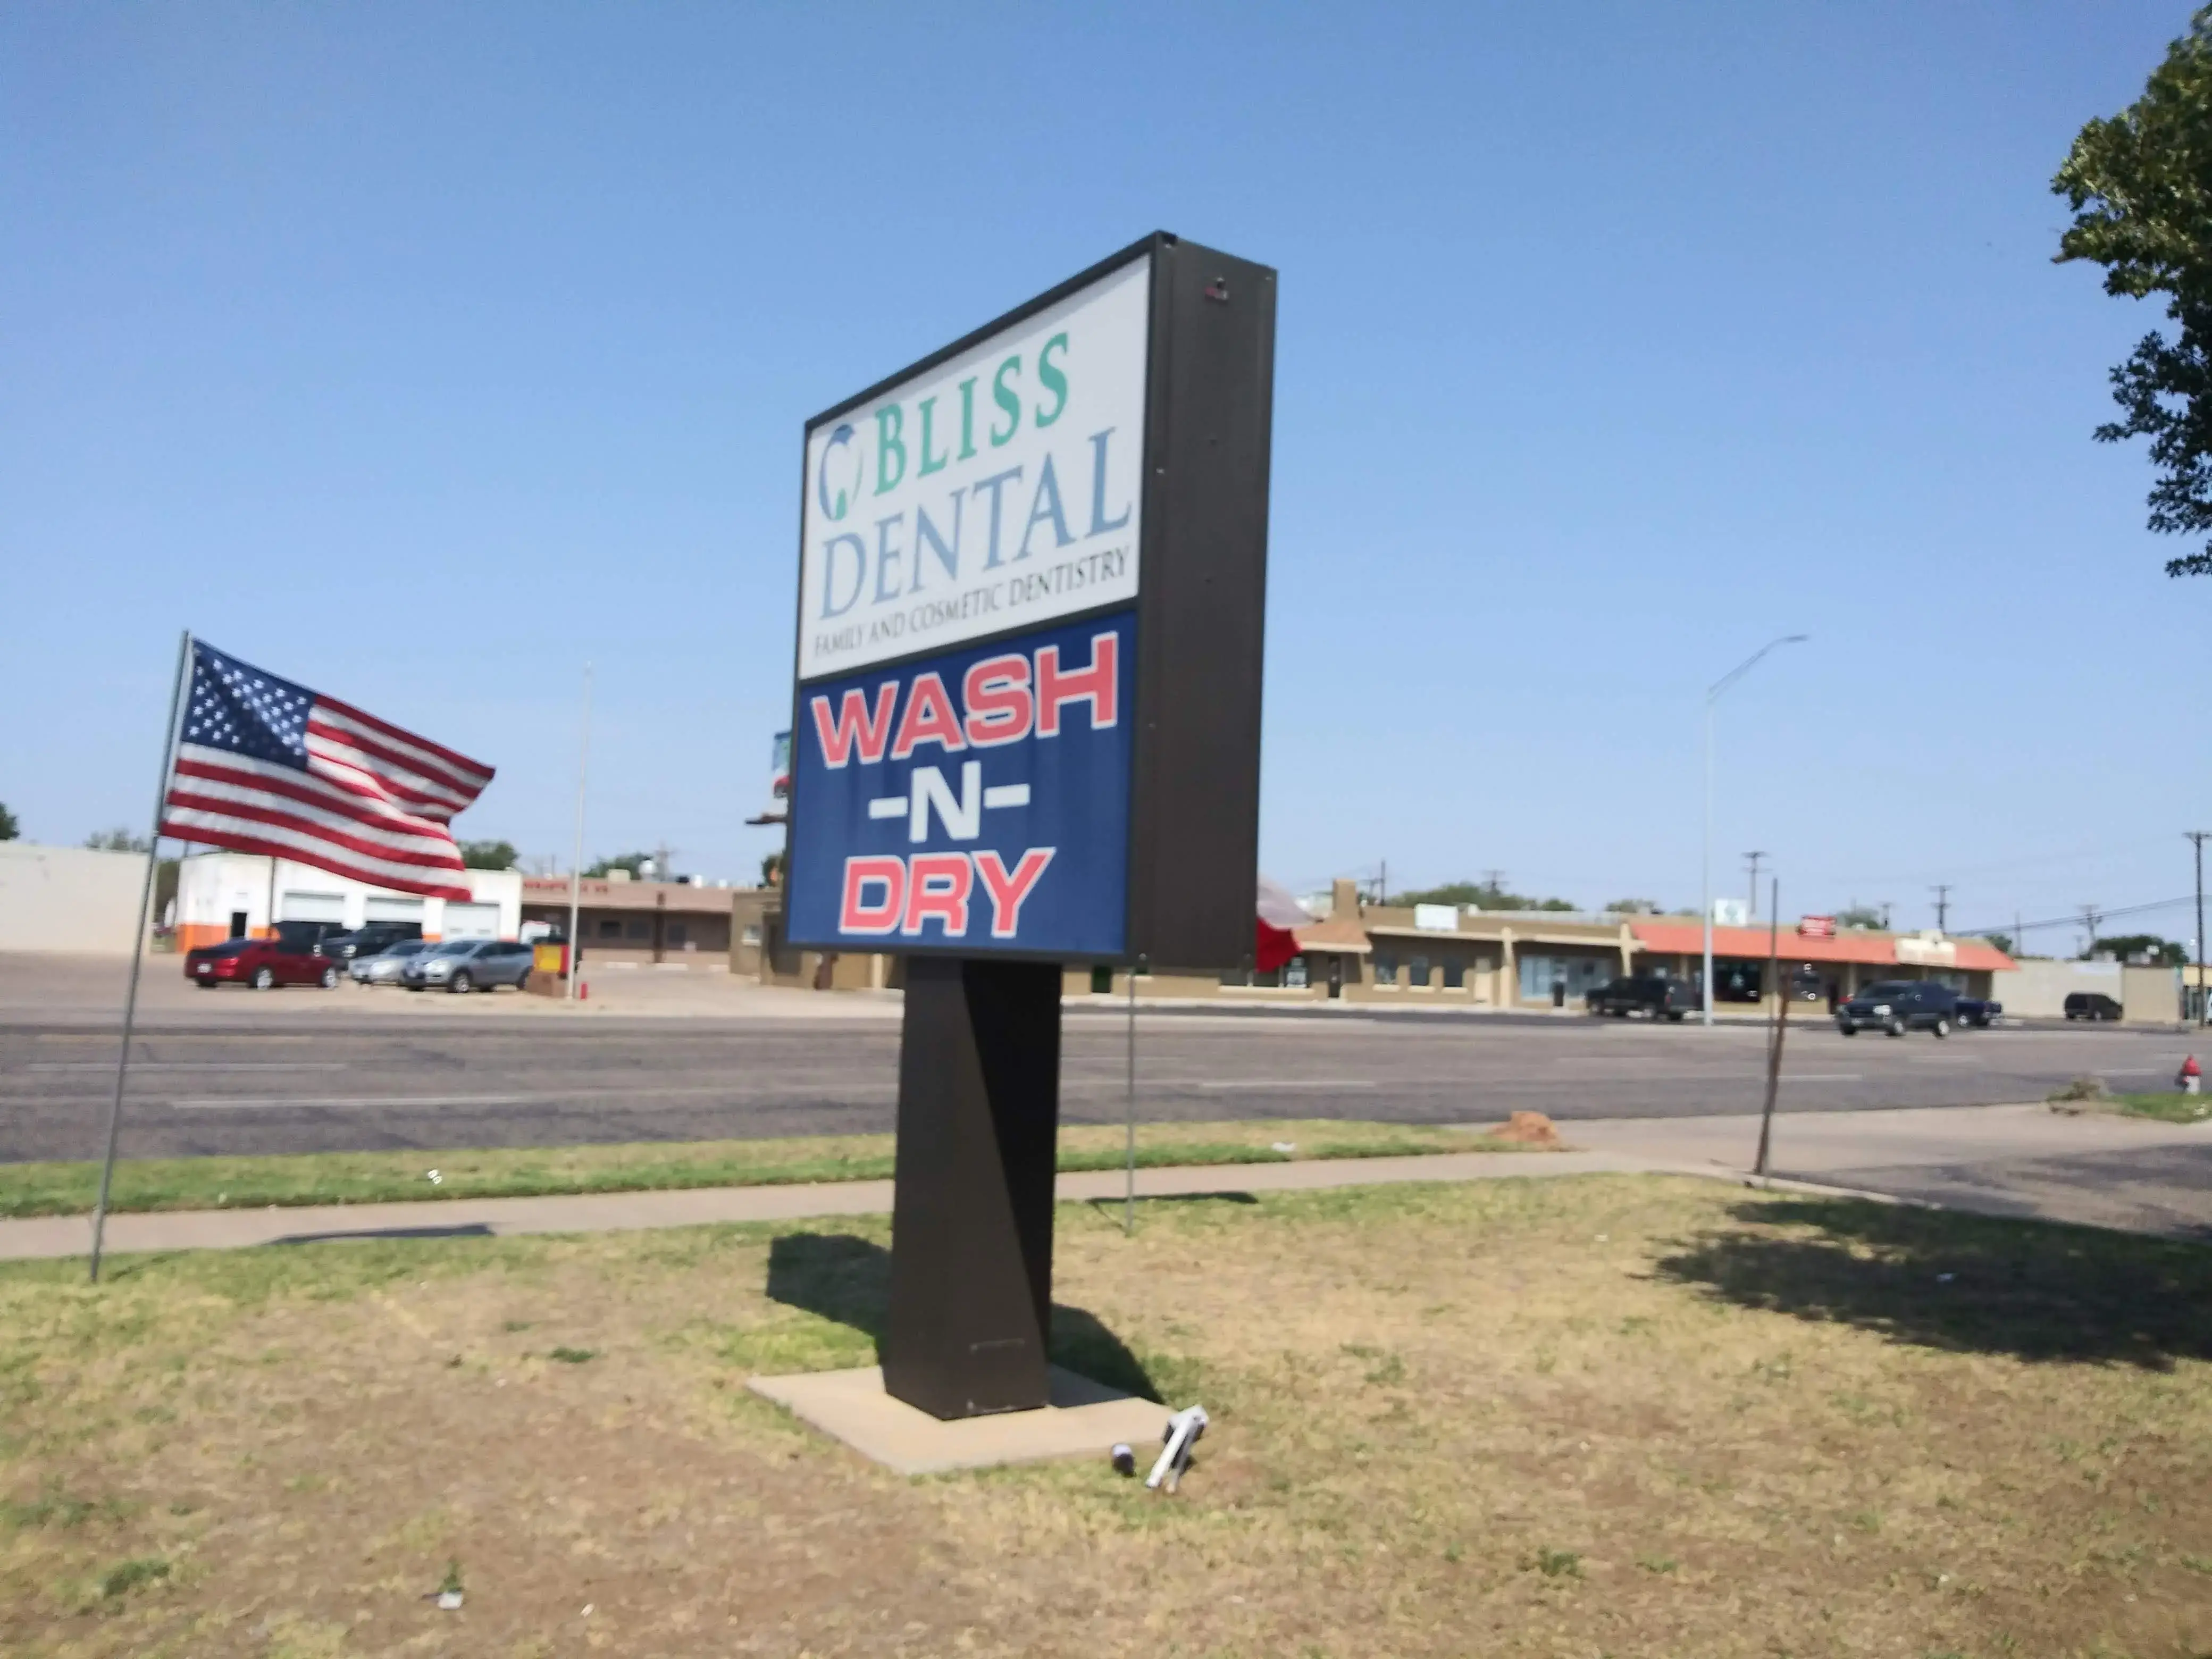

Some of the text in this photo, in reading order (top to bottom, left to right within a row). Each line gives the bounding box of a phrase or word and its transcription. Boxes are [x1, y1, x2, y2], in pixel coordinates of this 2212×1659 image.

[873, 331, 1069, 497] BLISS
[819, 427, 1131, 621] DENTAL
[814, 544, 1130, 656] FAMILY AND COSMETIC DENTISTRY
[811, 631, 1118, 769] WASH
[838, 847, 1057, 938] DRY
